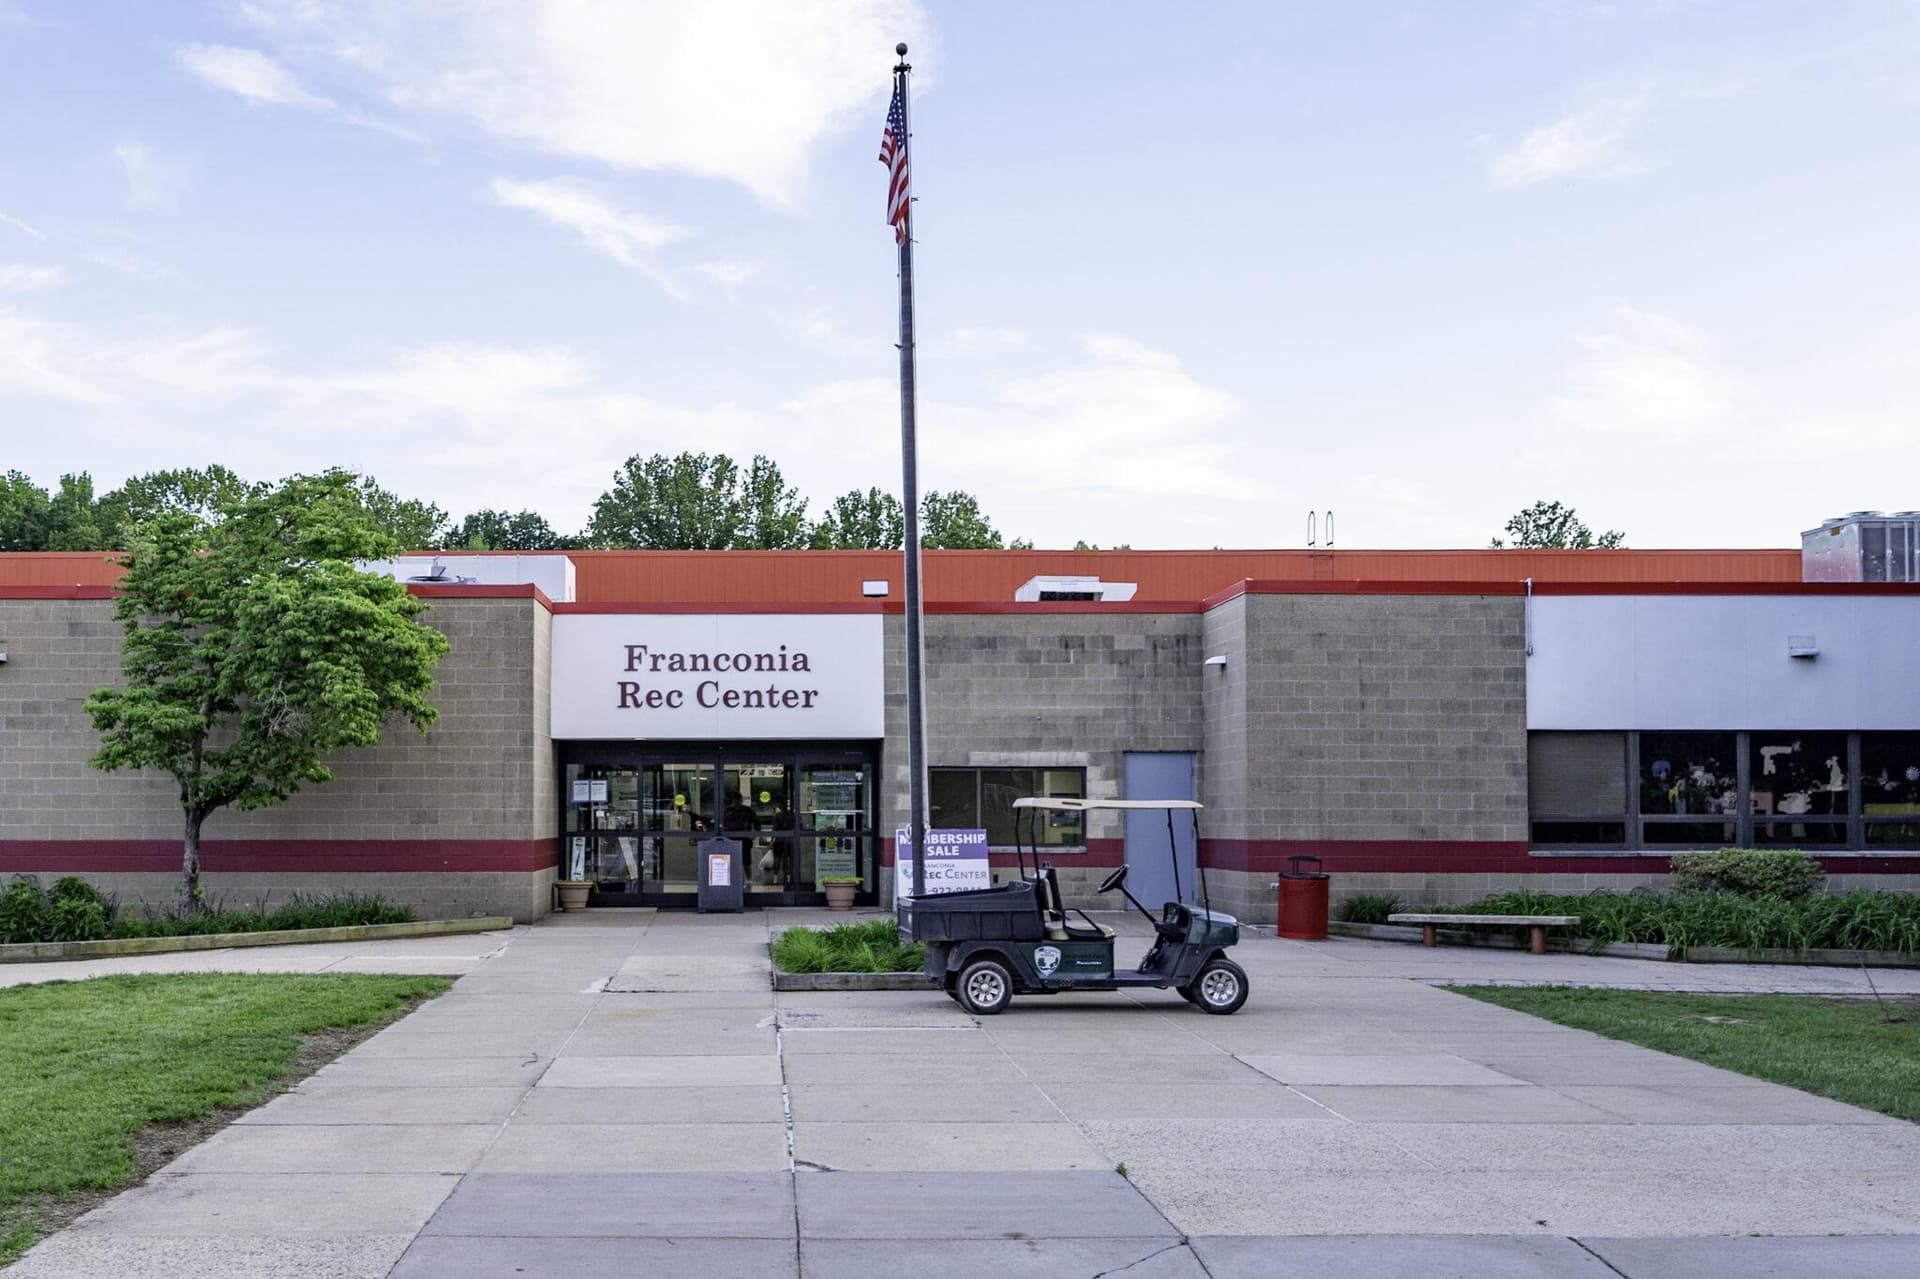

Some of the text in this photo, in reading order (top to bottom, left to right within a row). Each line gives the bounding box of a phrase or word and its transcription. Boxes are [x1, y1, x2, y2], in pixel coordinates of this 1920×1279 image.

[624, 645, 811, 672] Franconia
[617, 680, 819, 709] Rec Center
[899, 833, 986, 845] MBERSHIP
[927, 845, 960, 857] SALE
[924, 868, 988, 880] EC CENTER
